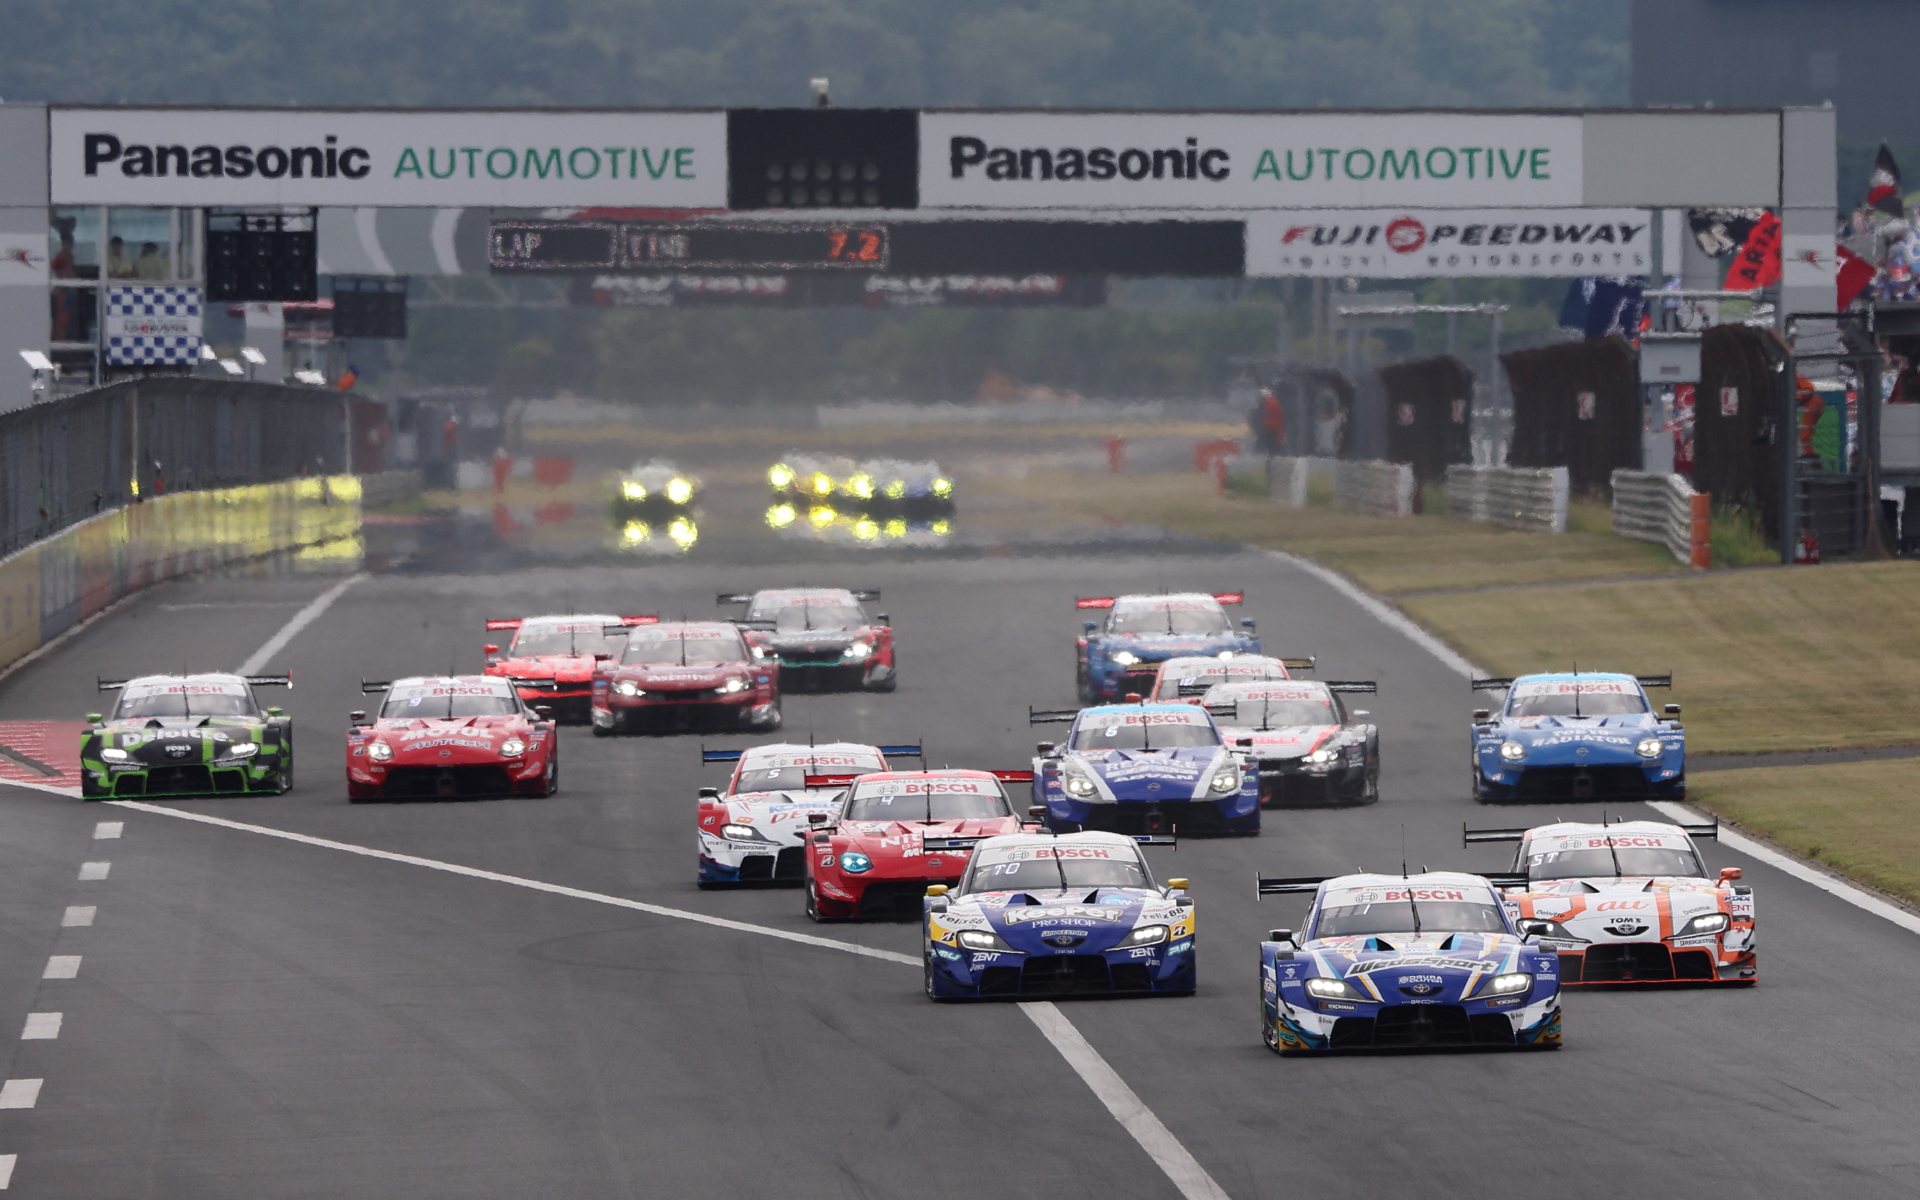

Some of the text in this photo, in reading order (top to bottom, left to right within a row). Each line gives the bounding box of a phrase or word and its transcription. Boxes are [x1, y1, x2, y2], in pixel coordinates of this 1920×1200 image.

[84, 133, 696, 180] Panasonic AUTOMOTIVE
[950, 135, 1551, 181] Panasonic AUTOMOTIVE
[1281, 225, 1380, 247] FUJI
[432, 687, 493, 695] BOSCH
[1559, 684, 1622, 693] BOSCH
[1247, 692, 1310, 700] BOSCH
[1125, 715, 1190, 724] BOSCH
[401, 728, 494, 741] MOTUL
[403, 739, 491, 751] AUTECH
[1532, 735, 1632, 747] RADIATOR
[793, 757, 857, 766] BOSCH
[906, 784, 978, 793] BOSCH
[882, 796, 895, 805] 4
[1588, 838, 1663, 847] BOSCH
[1035, 849, 1110, 858] BOSCH
[1385, 890, 1464, 900] BOSCH
[1597, 900, 1650, 912] au
[1003, 905, 1124, 926] KeePer
[1142, 907, 1184, 920] Felix88
[939, 914, 985, 925] Felix88
[1032, 918, 1096, 929] PRO SHOP
[972, 952, 1001, 962] ZENT
[1129, 947, 1155, 958] ZENT
[1348, 957, 1497, 976] WedsSport
